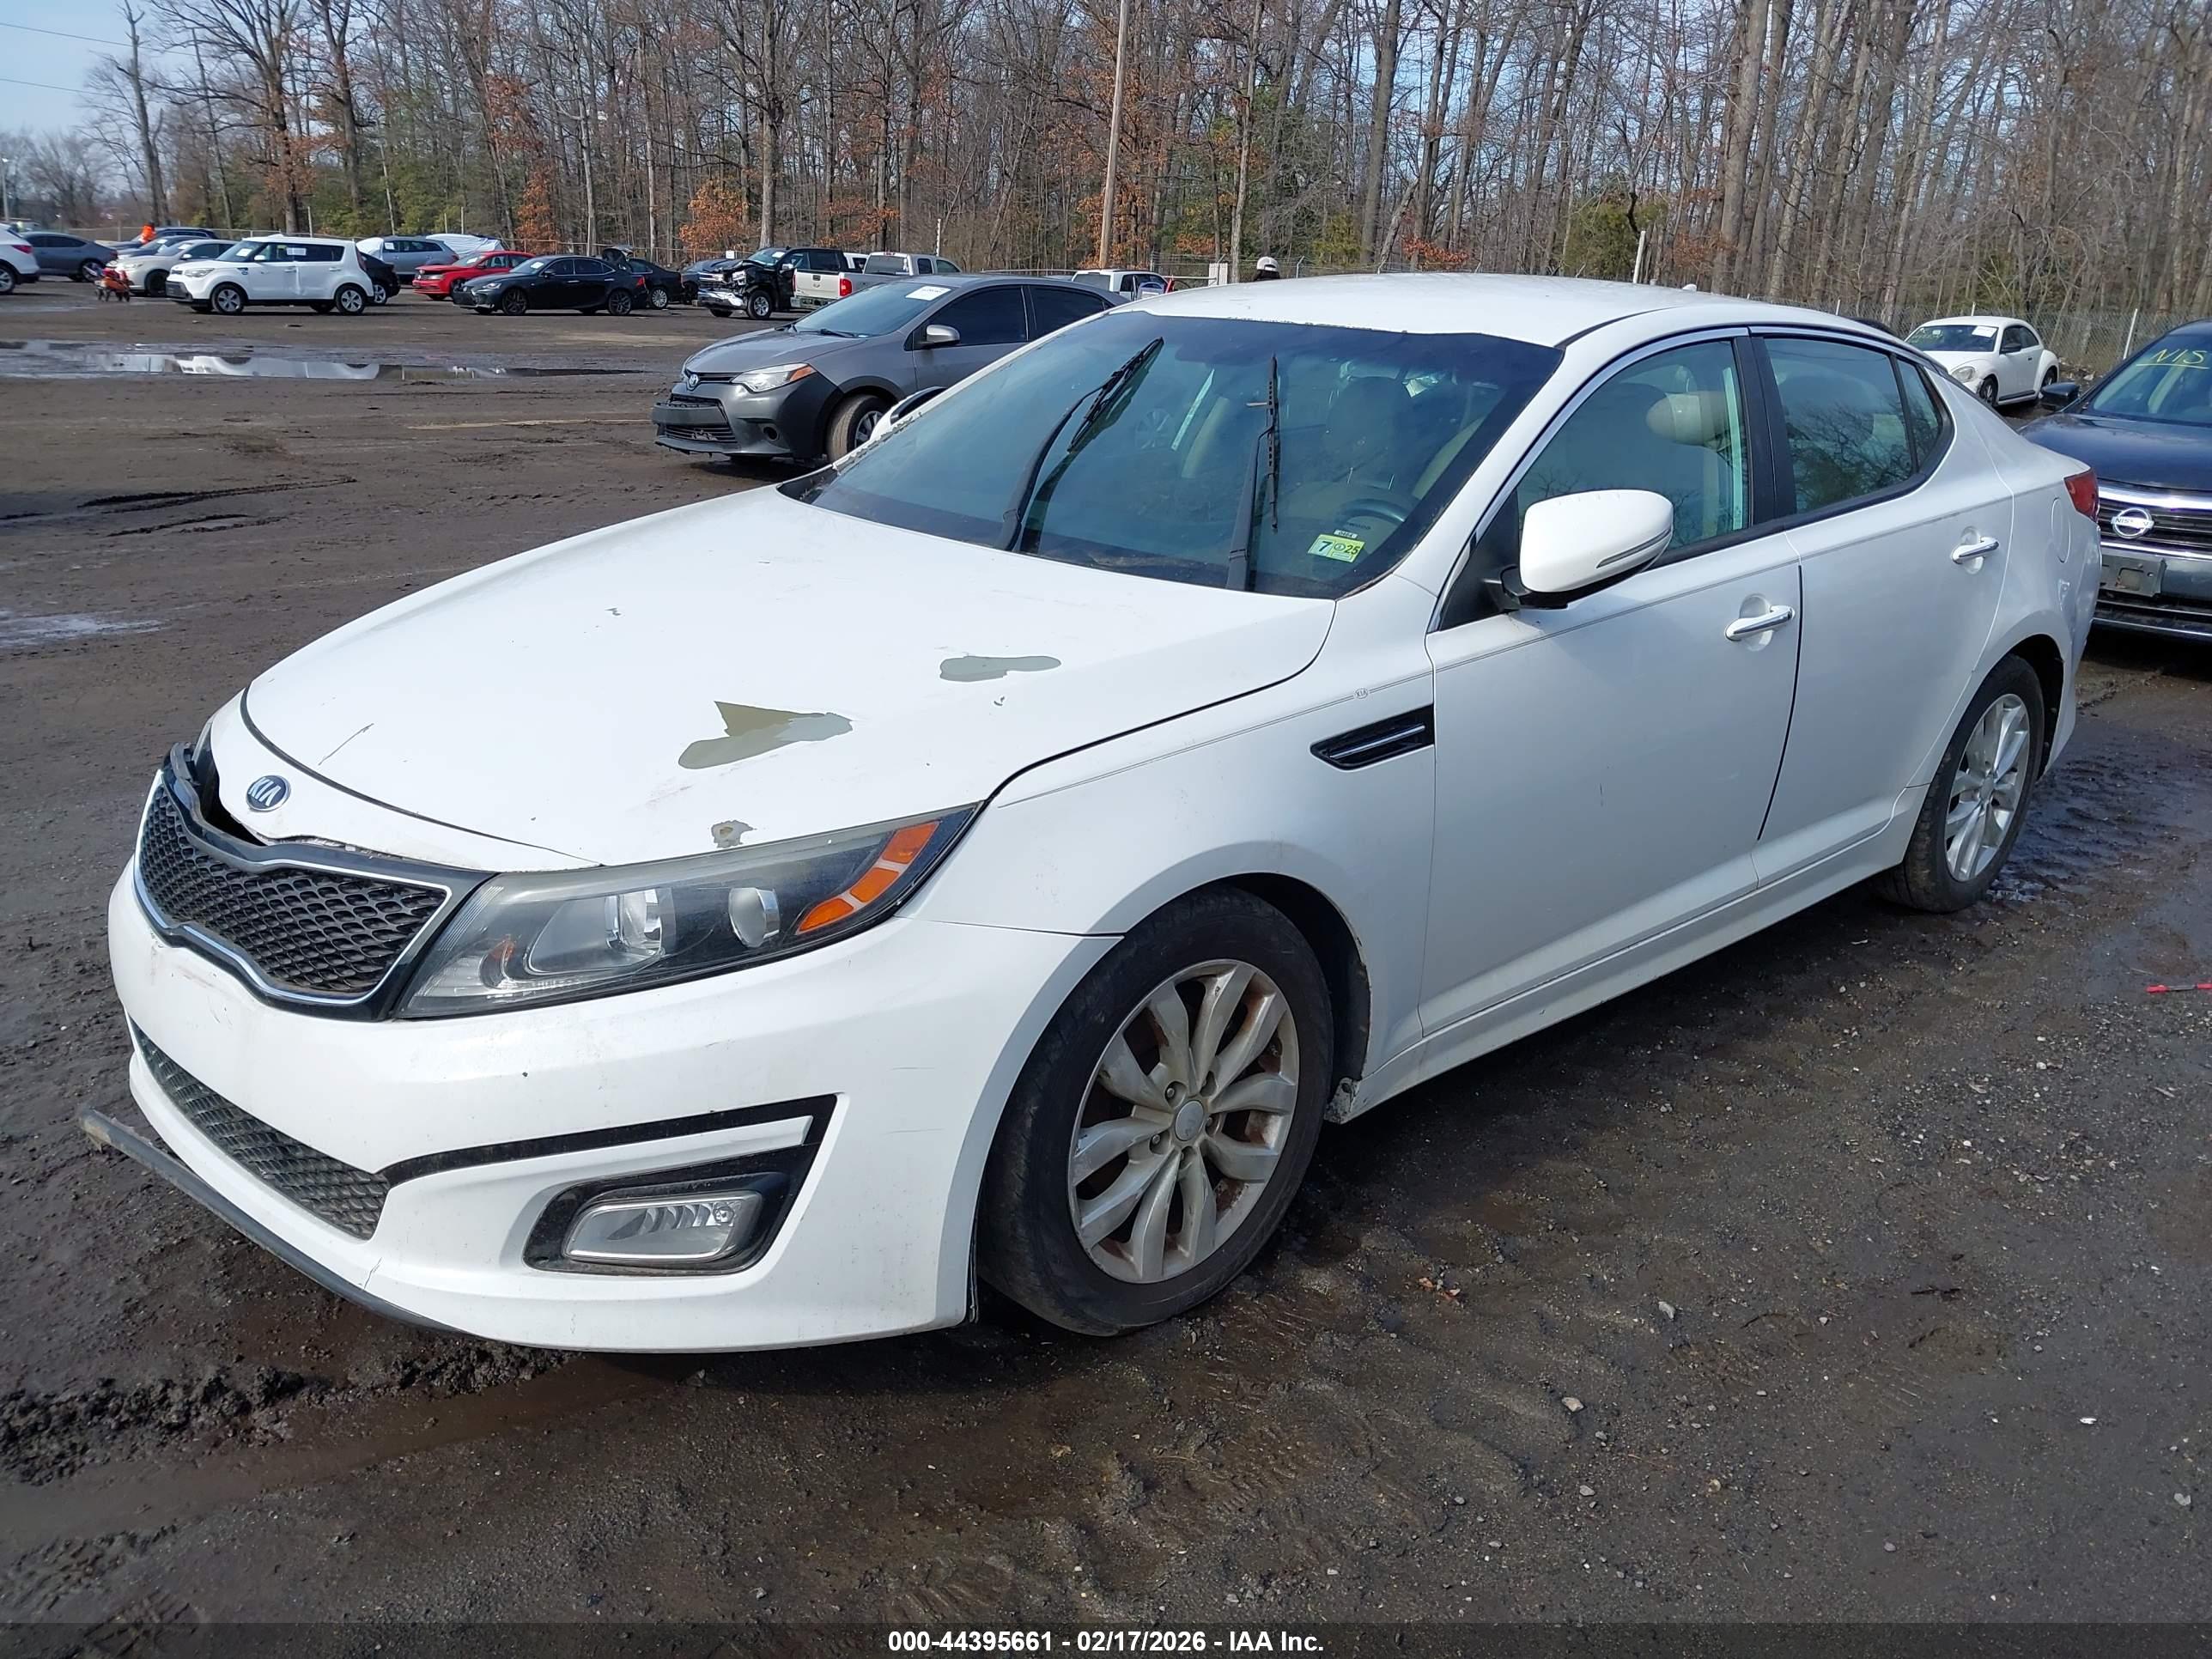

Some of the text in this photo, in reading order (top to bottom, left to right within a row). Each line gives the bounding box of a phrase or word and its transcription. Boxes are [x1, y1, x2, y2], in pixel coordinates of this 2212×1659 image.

[2115, 517, 2149, 526] NISN
[1318, 540, 1361, 555] 7 25
[247, 776, 282, 807] KIA
